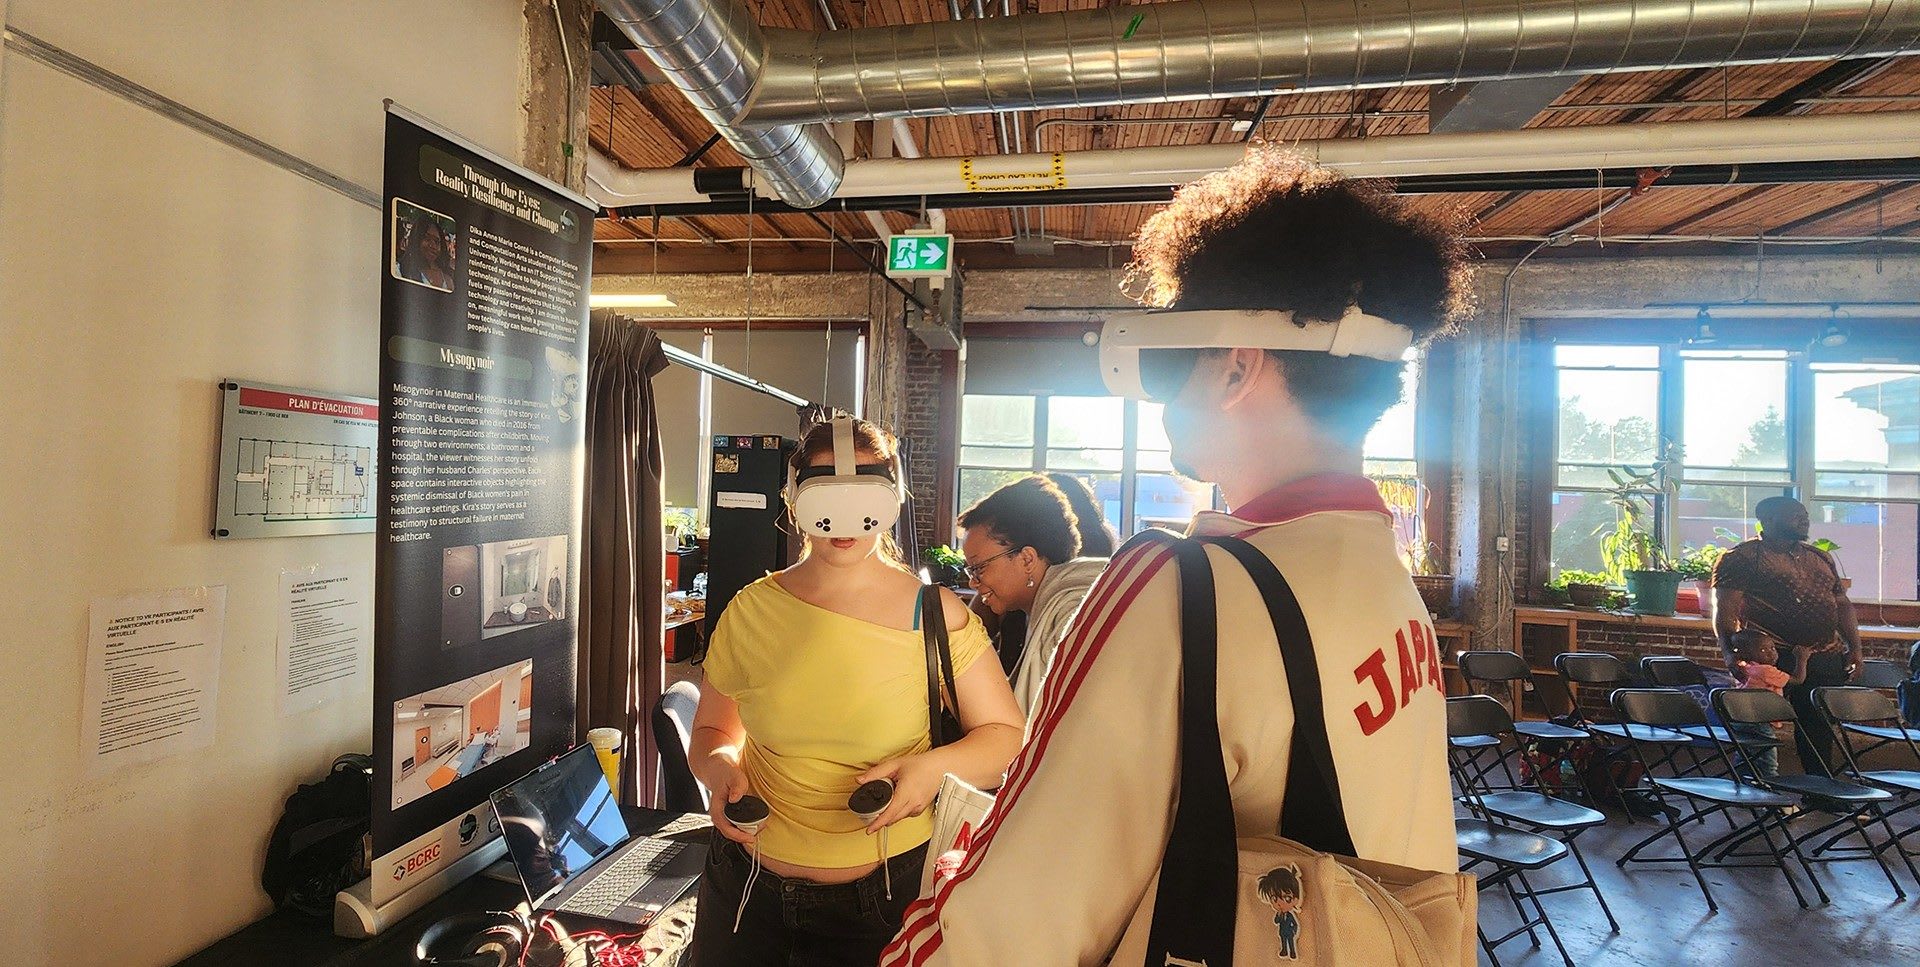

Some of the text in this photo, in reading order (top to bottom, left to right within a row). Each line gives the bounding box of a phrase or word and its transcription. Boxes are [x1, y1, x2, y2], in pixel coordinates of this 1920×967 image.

[463, 164, 540, 210] Through Our Eyes:
[436, 168, 558, 234] Reality Resilience and Change
[483, 230, 497, 241] Anne
[539, 250, 561, 264] Computer
[470, 260, 498, 272] reinforced
[507, 269, 522, 280] desire
[500, 256, 520, 272] Working
[468, 279, 483, 289] fuels
[468, 290, 499, 305] technology
[468, 312, 480, 320] how
[481, 314, 510, 329] technology
[440, 348, 494, 370] Mysogynoir
[393, 384, 434, 396] Misogynoir
[436, 388, 442, 396] in
[444, 389, 474, 400] Maternal
[289, 398, 363, 415] PLAN D'ÉVACUATION
[392, 398, 412, 406] 360°
[414, 401, 446, 410] narrative
[447, 404, 483, 413] experience
[392, 411, 427, 423] Johnson,
[434, 414, 453, 423] Black
[393, 426, 437, 435] preventable
[438, 428, 485, 439] complications
[392, 438, 422, 450] through
[423, 440, 437, 448] two
[392, 452, 424, 463] hospital,
[392, 466, 421, 476] through
[391, 481, 414, 490] space
[415, 479, 446, 487] contains
[447, 478, 482, 486] interactive
[391, 492, 424, 504] systemic
[426, 491, 457, 500] dismissal
[468, 490, 484, 498] Black
[391, 506, 430, 514] healthcare
[432, 504, 461, 514] settings.
[462, 503, 479, 511] Kira's
[480, 502, 495, 512] story
[390, 520, 428, 529] testimony
[439, 515, 471, 525] structural
[390, 533, 431, 542] healthcare.
[152, 610, 188, 618] PARTICIPANTS
[1354, 620, 1446, 736] JAPA
[407, 844, 440, 873] BCRC
